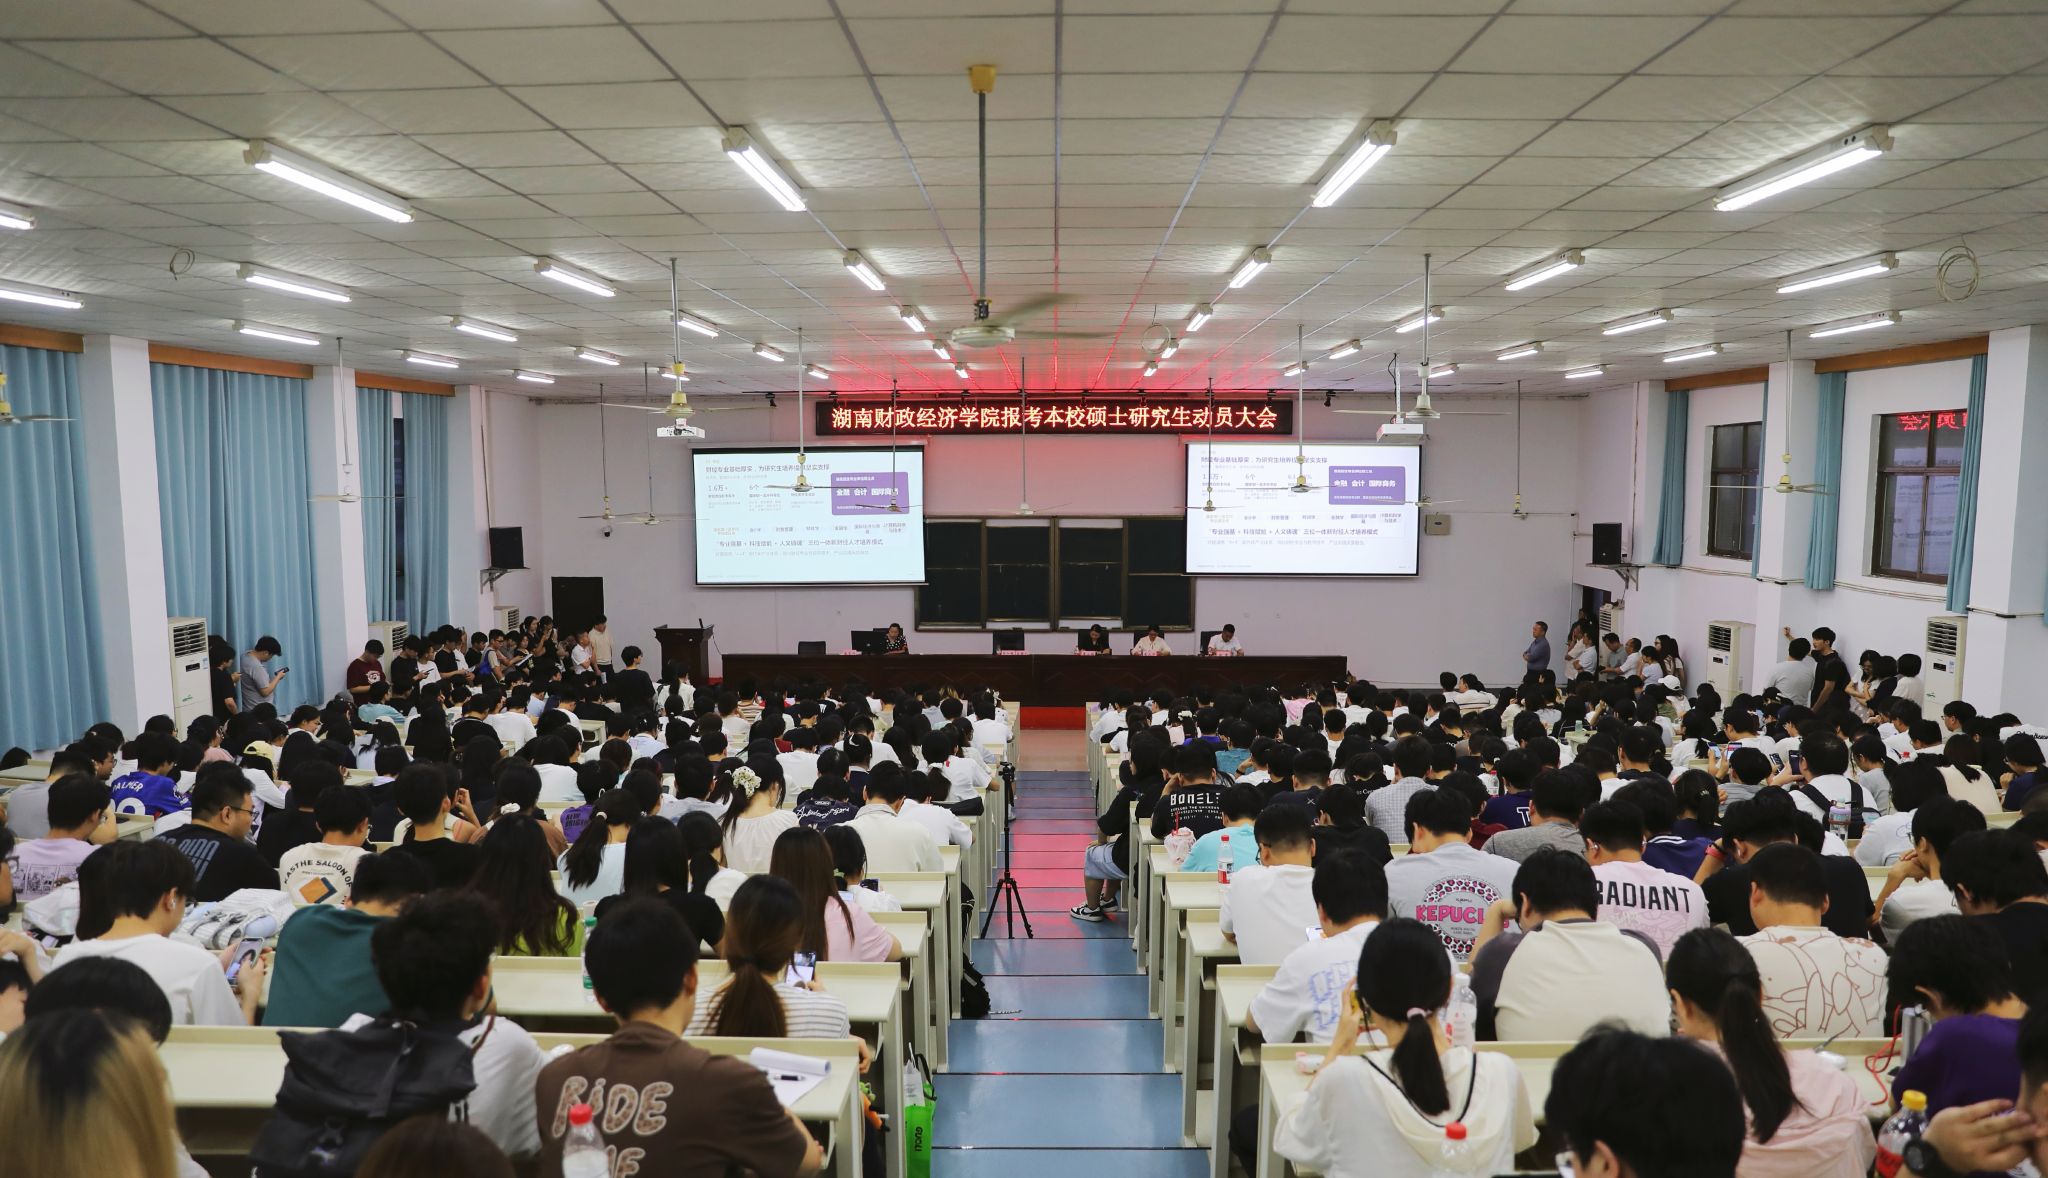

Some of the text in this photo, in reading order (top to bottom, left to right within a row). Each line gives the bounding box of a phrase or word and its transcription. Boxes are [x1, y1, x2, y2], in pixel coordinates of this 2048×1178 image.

[832, 406, 1277, 428] 湖南财政经济学院报考本校硕士研究生动员大会
